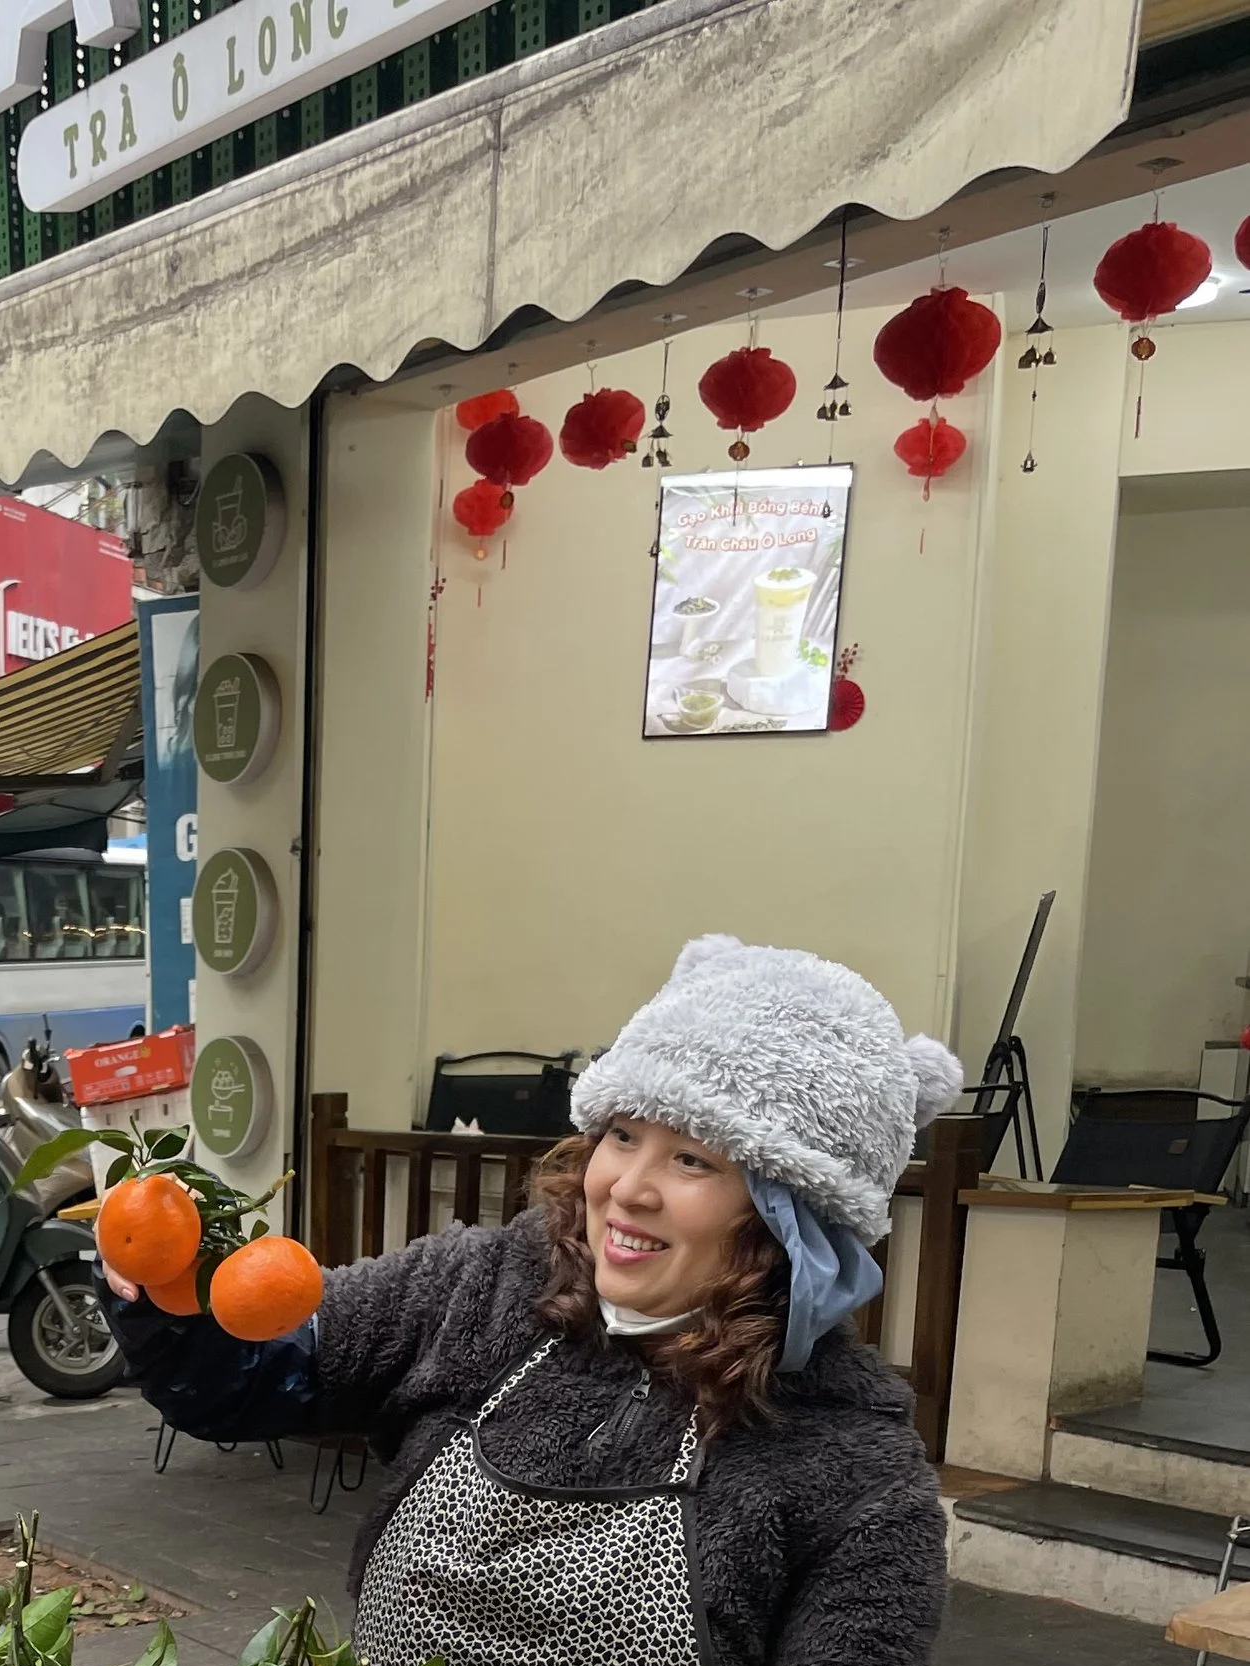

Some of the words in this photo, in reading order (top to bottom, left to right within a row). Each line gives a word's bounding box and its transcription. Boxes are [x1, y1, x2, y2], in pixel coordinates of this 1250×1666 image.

[62, 83, 138, 180] TRÀ
[171, 52, 189, 122] Ô
[225, 0, 348, 97] LONG
[778, 527, 818, 547] Long
[6, 609, 61, 661] IELTS
[93, 1050, 140, 1068] ORANGE
